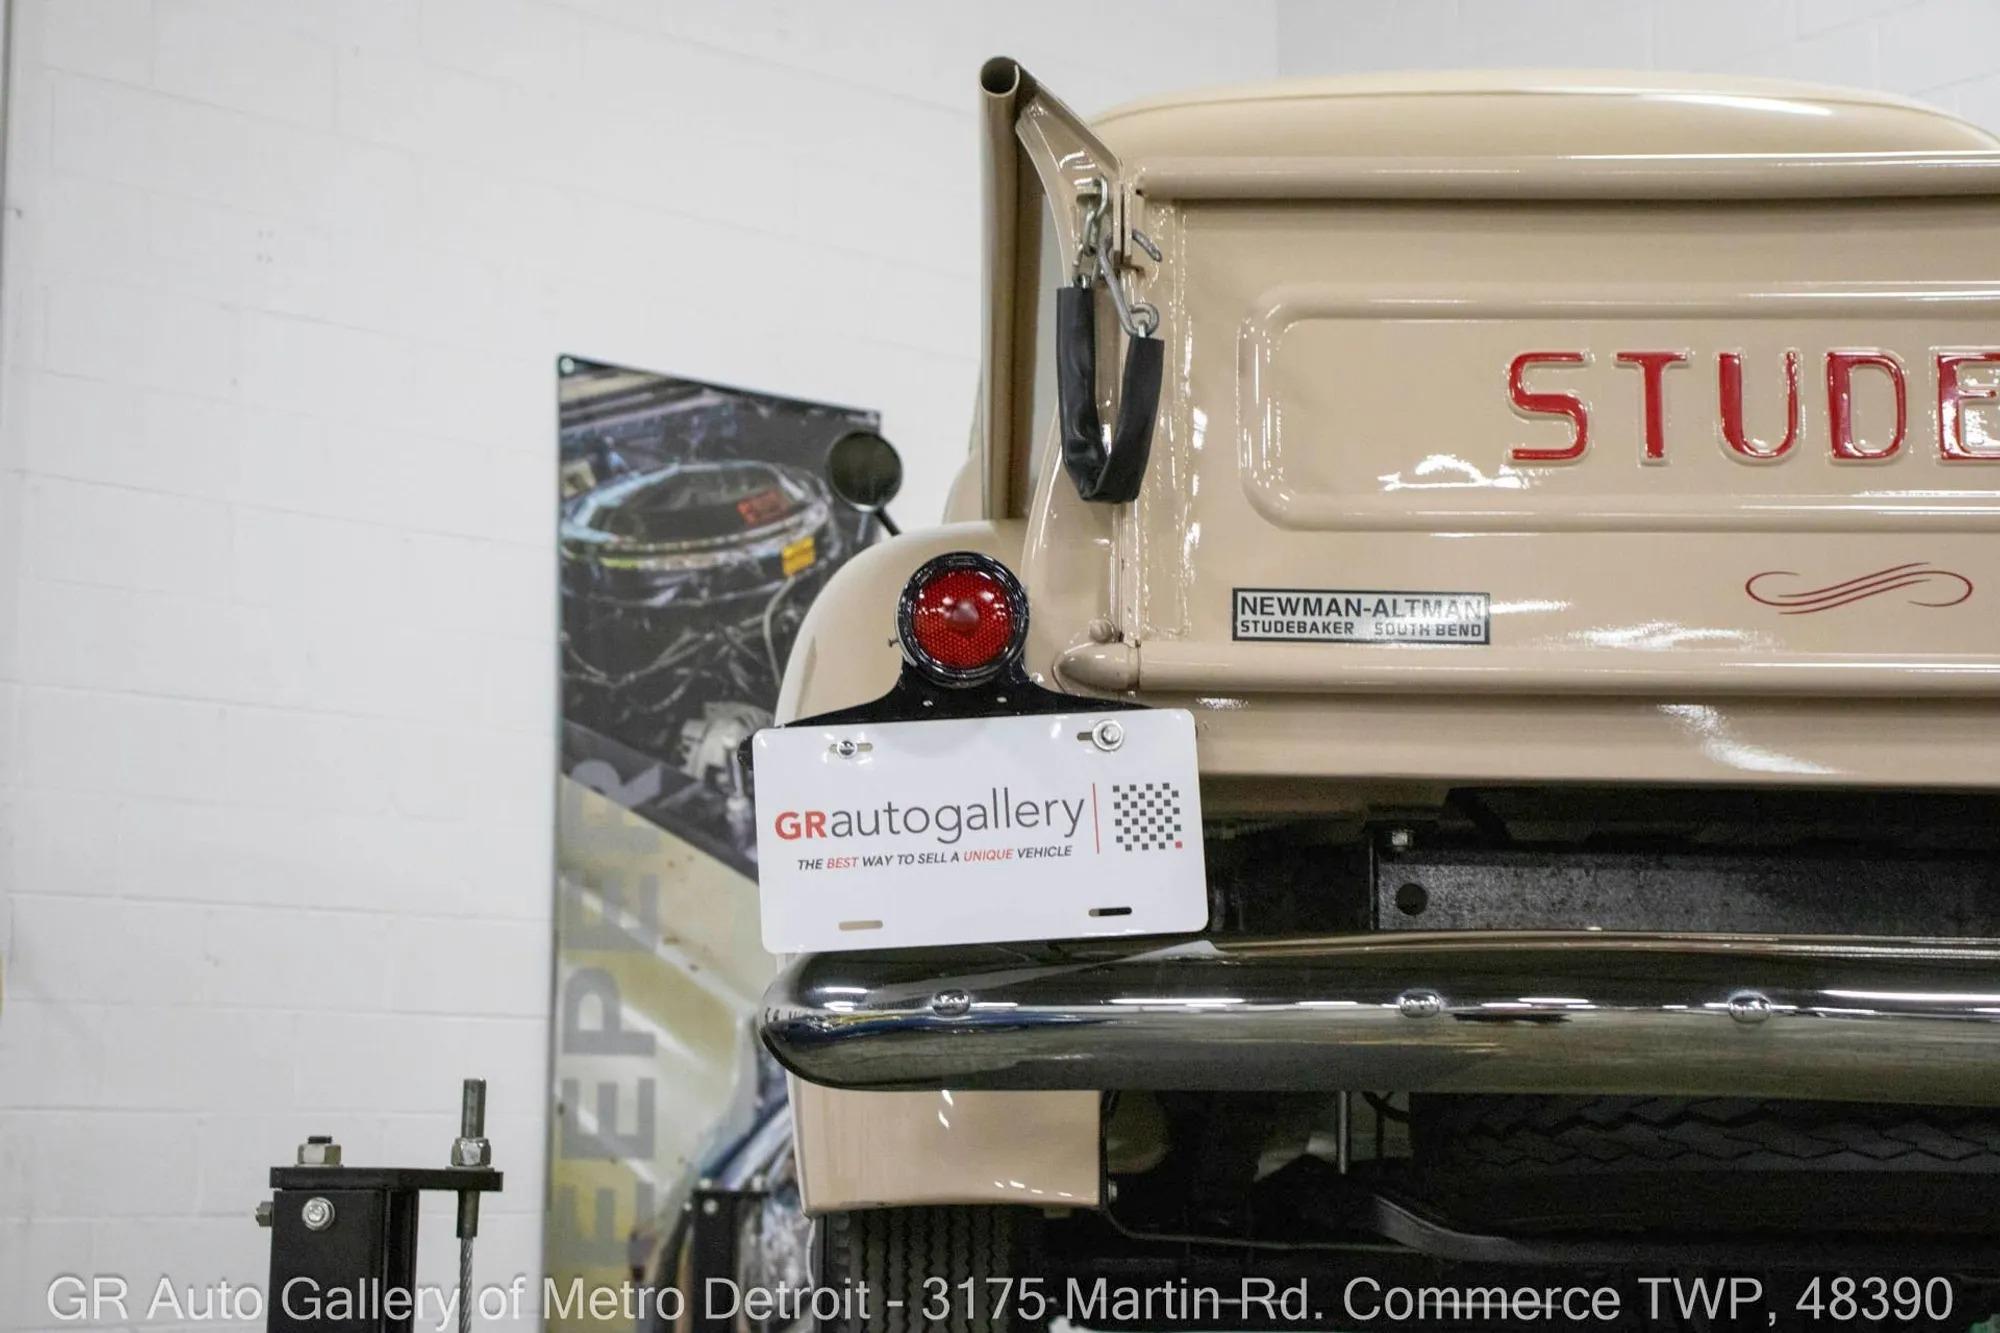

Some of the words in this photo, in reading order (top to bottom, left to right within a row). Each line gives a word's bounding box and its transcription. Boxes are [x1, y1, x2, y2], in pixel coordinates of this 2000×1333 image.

[1508, 351, 2000, 461] STUDE
[1240, 595, 1483, 620] NEWMAN-ALTMAN
[1240, 620, 1355, 636] STUDEBAKER
[1374, 621, 1431, 637] SOUTH
[1435, 623, 1482, 637] BEND
[798, 858, 823, 870] THE
[827, 857, 859, 869] BEST
[862, 855, 892, 868] WAY
[897, 853, 915, 866] TO
[918, 852, 947, 864] SELL
[950, 851, 960, 862] A
[963, 848, 1013, 862] UNIQUE
[1017, 845, 1073, 859] VEHICLE
